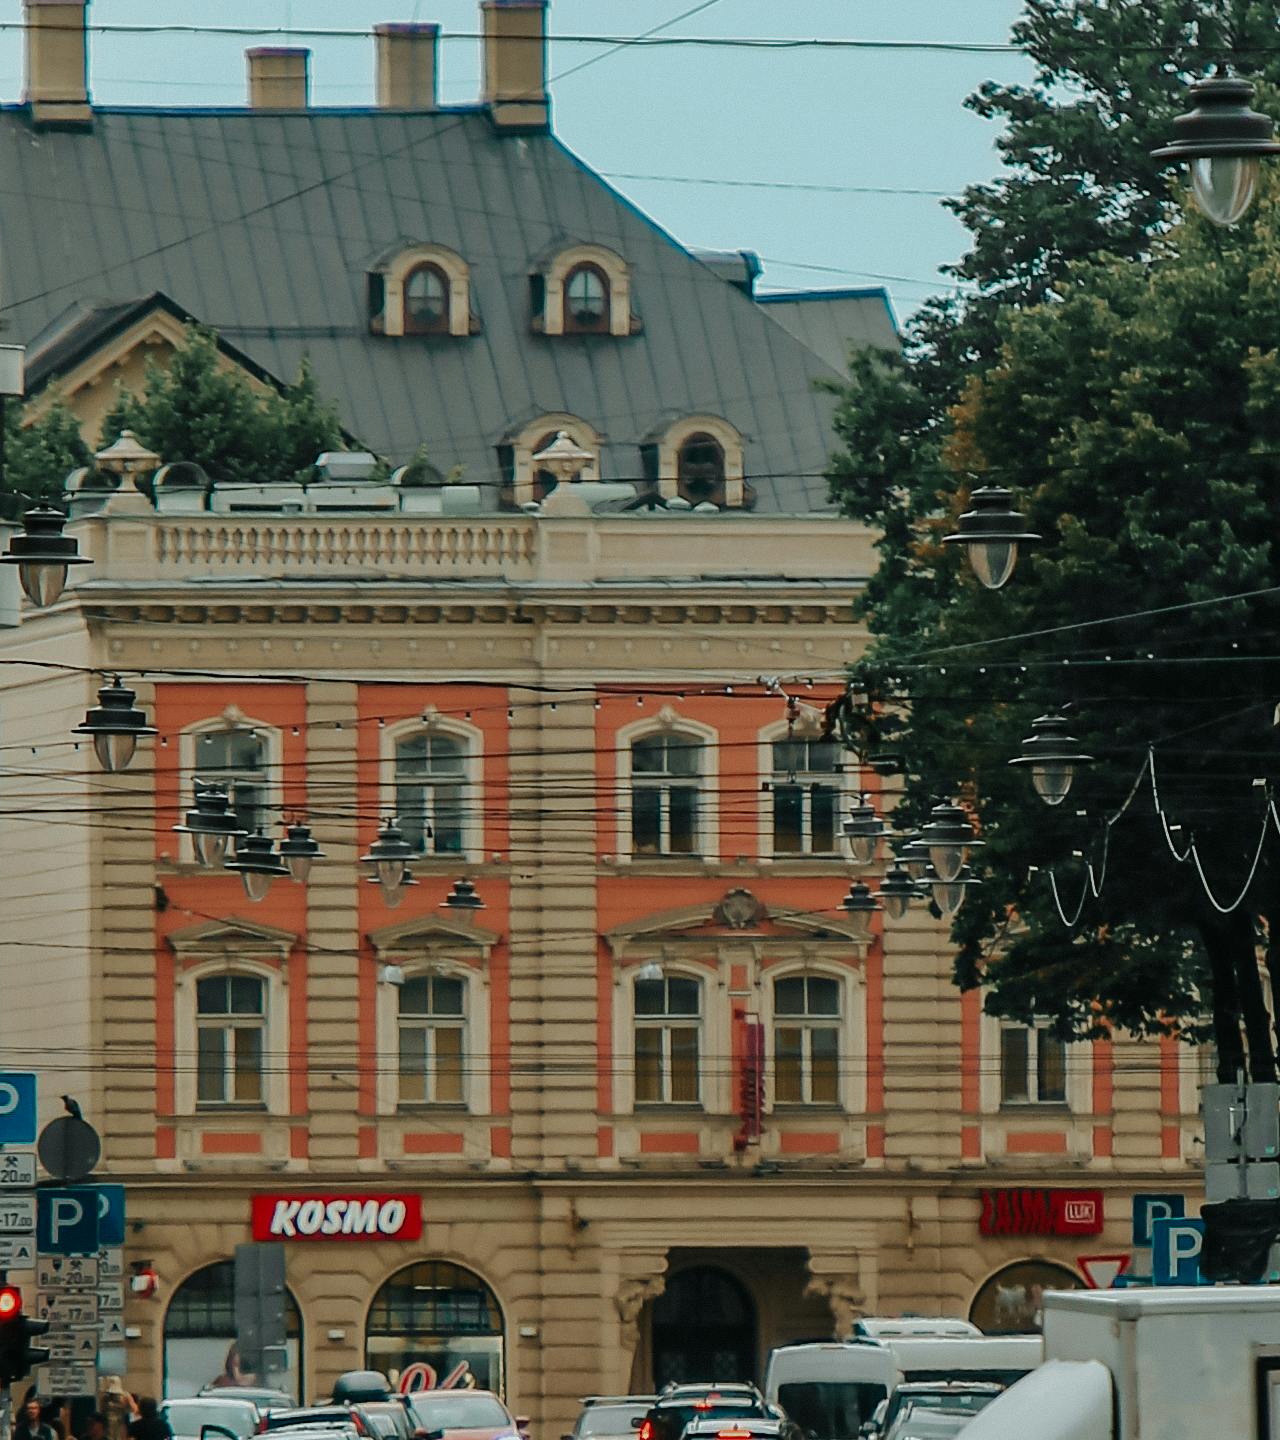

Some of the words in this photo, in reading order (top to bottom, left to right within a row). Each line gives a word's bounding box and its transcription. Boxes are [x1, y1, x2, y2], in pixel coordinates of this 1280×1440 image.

[51, 1197, 83, 1244] P
[270, 1199, 407, 1237] KOSMO
[16, 1247, 29, 1258] A
[1169, 1226, 1203, 1278] P
[81, 1340, 93, 1350] A
